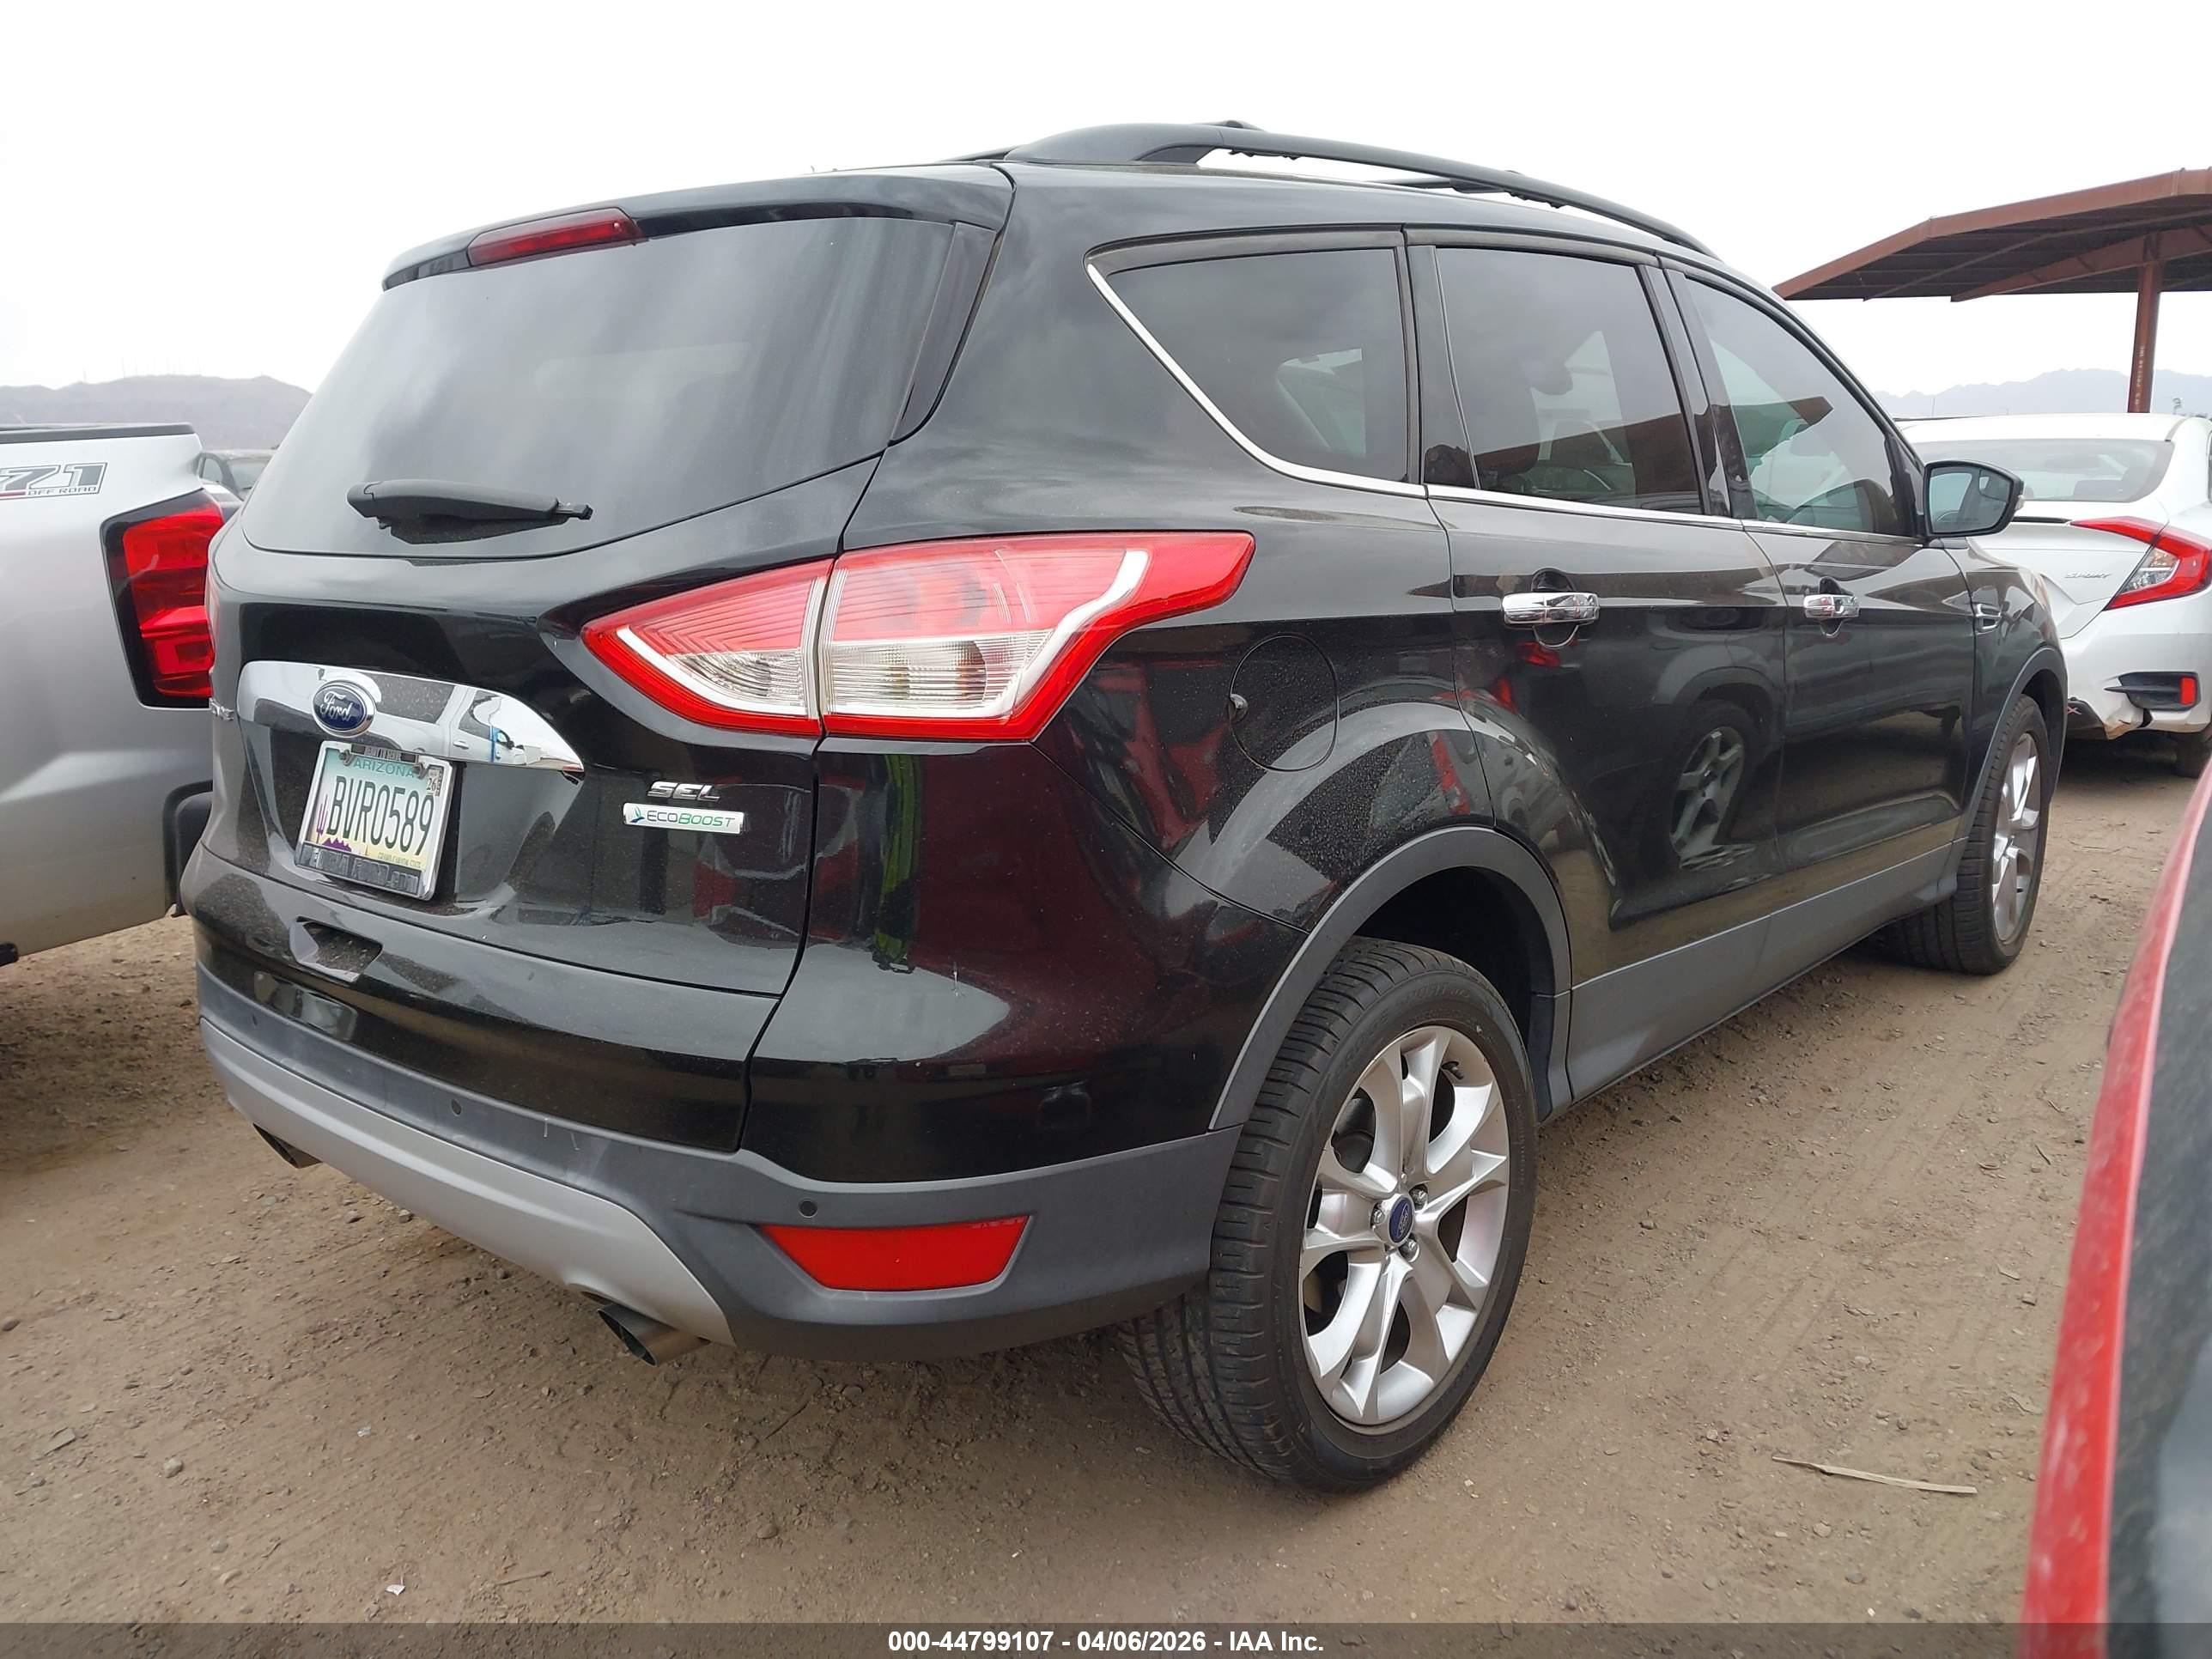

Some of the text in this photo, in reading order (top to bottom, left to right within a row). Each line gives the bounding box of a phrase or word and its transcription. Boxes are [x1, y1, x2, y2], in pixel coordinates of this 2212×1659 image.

[319, 690, 353, 722] Ford
[353, 758, 415, 778] ARIZONA
[647, 781, 720, 801] SEL
[326, 775, 434, 855] BVR0589
[647, 810, 735, 827] ECOBOOST
